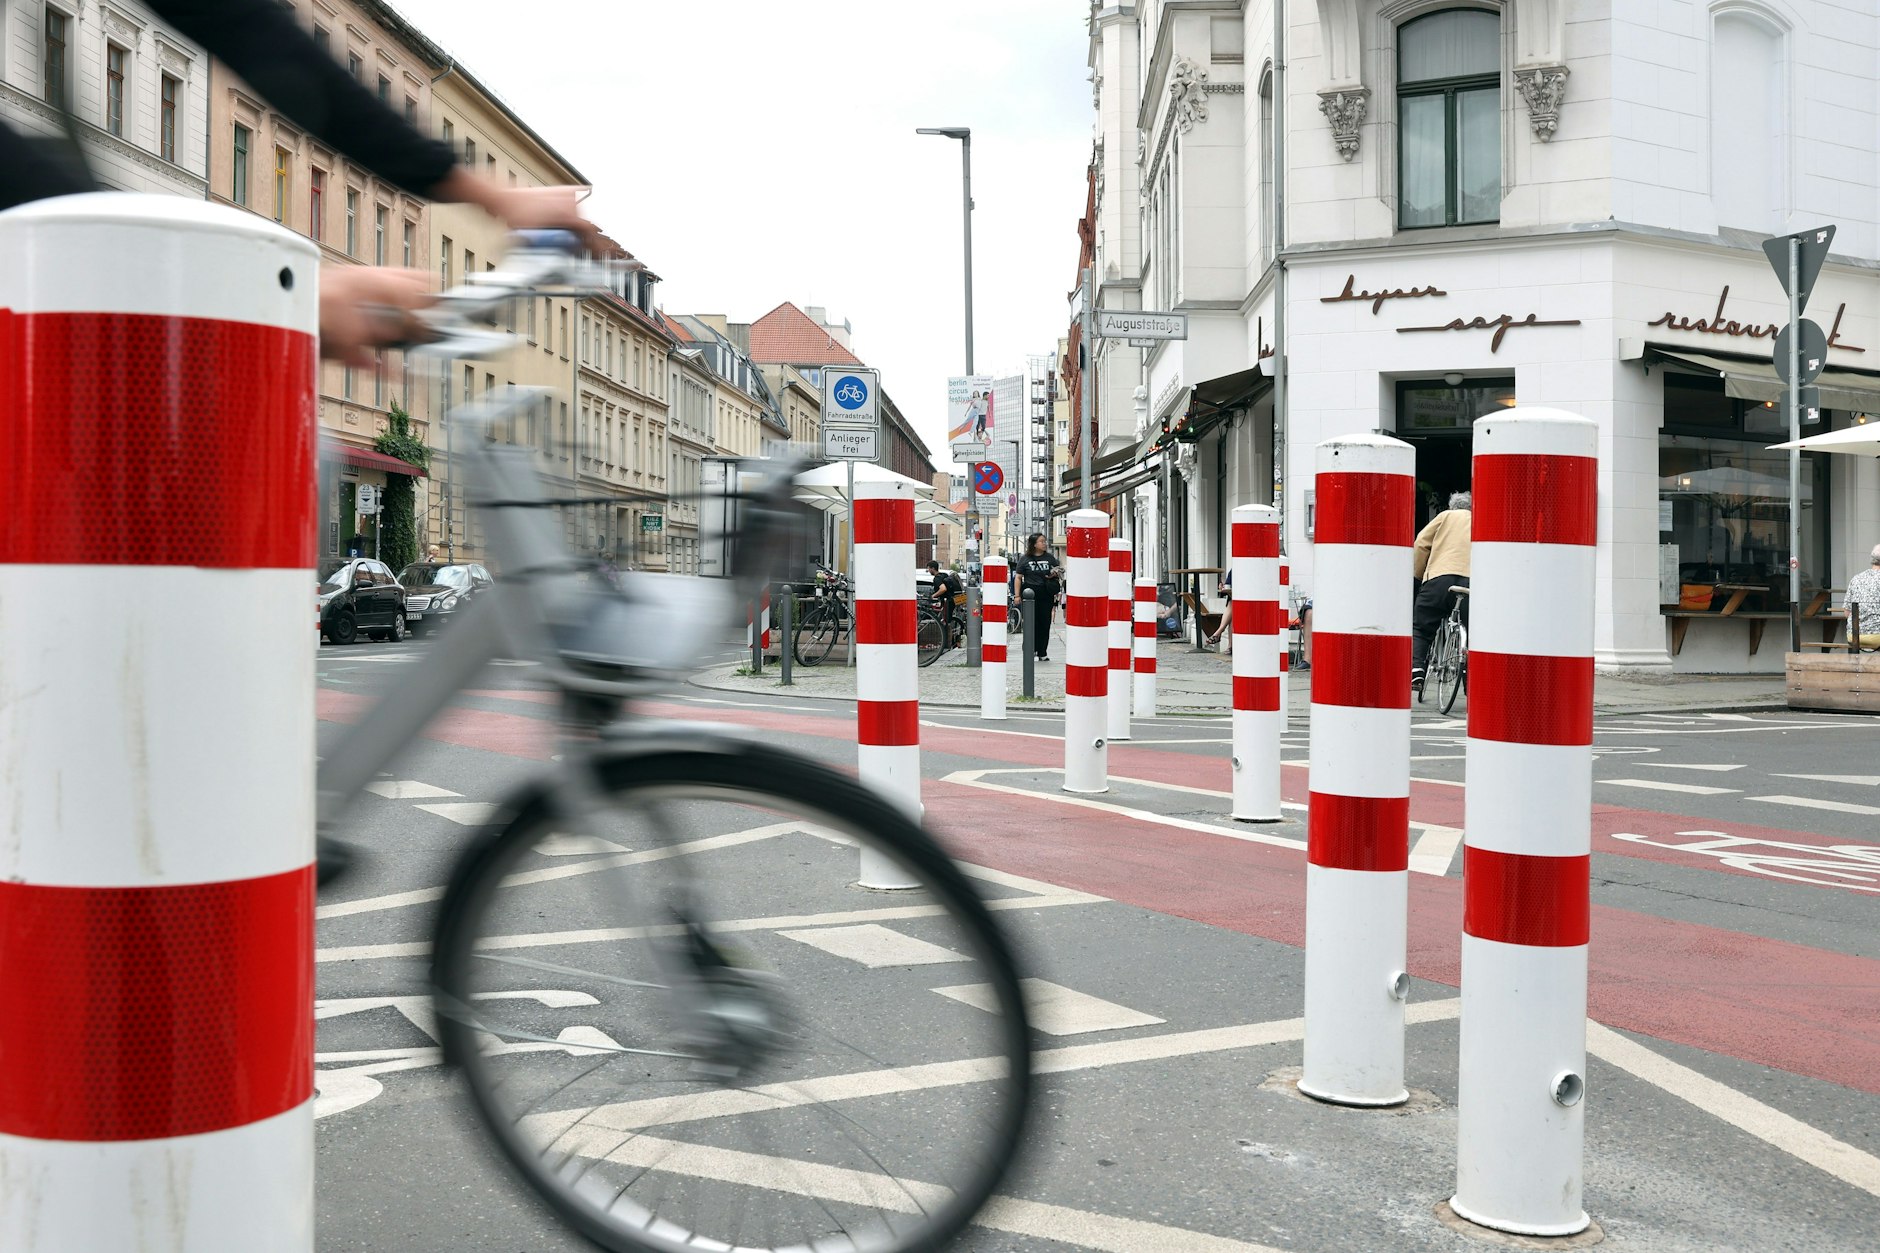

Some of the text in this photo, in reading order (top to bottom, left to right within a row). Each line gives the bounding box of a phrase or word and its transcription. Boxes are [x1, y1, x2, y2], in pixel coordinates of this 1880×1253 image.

[1648, 284, 1866, 353] restaurt
[1106, 316, 1180, 334] Auguststraße
[948, 379, 967, 387] berlin
[948, 387, 969, 395] circus
[827, 411, 873, 420] Fahrradstraße
[830, 433, 871, 445] Anlieger
[842, 444, 859, 454] frei
